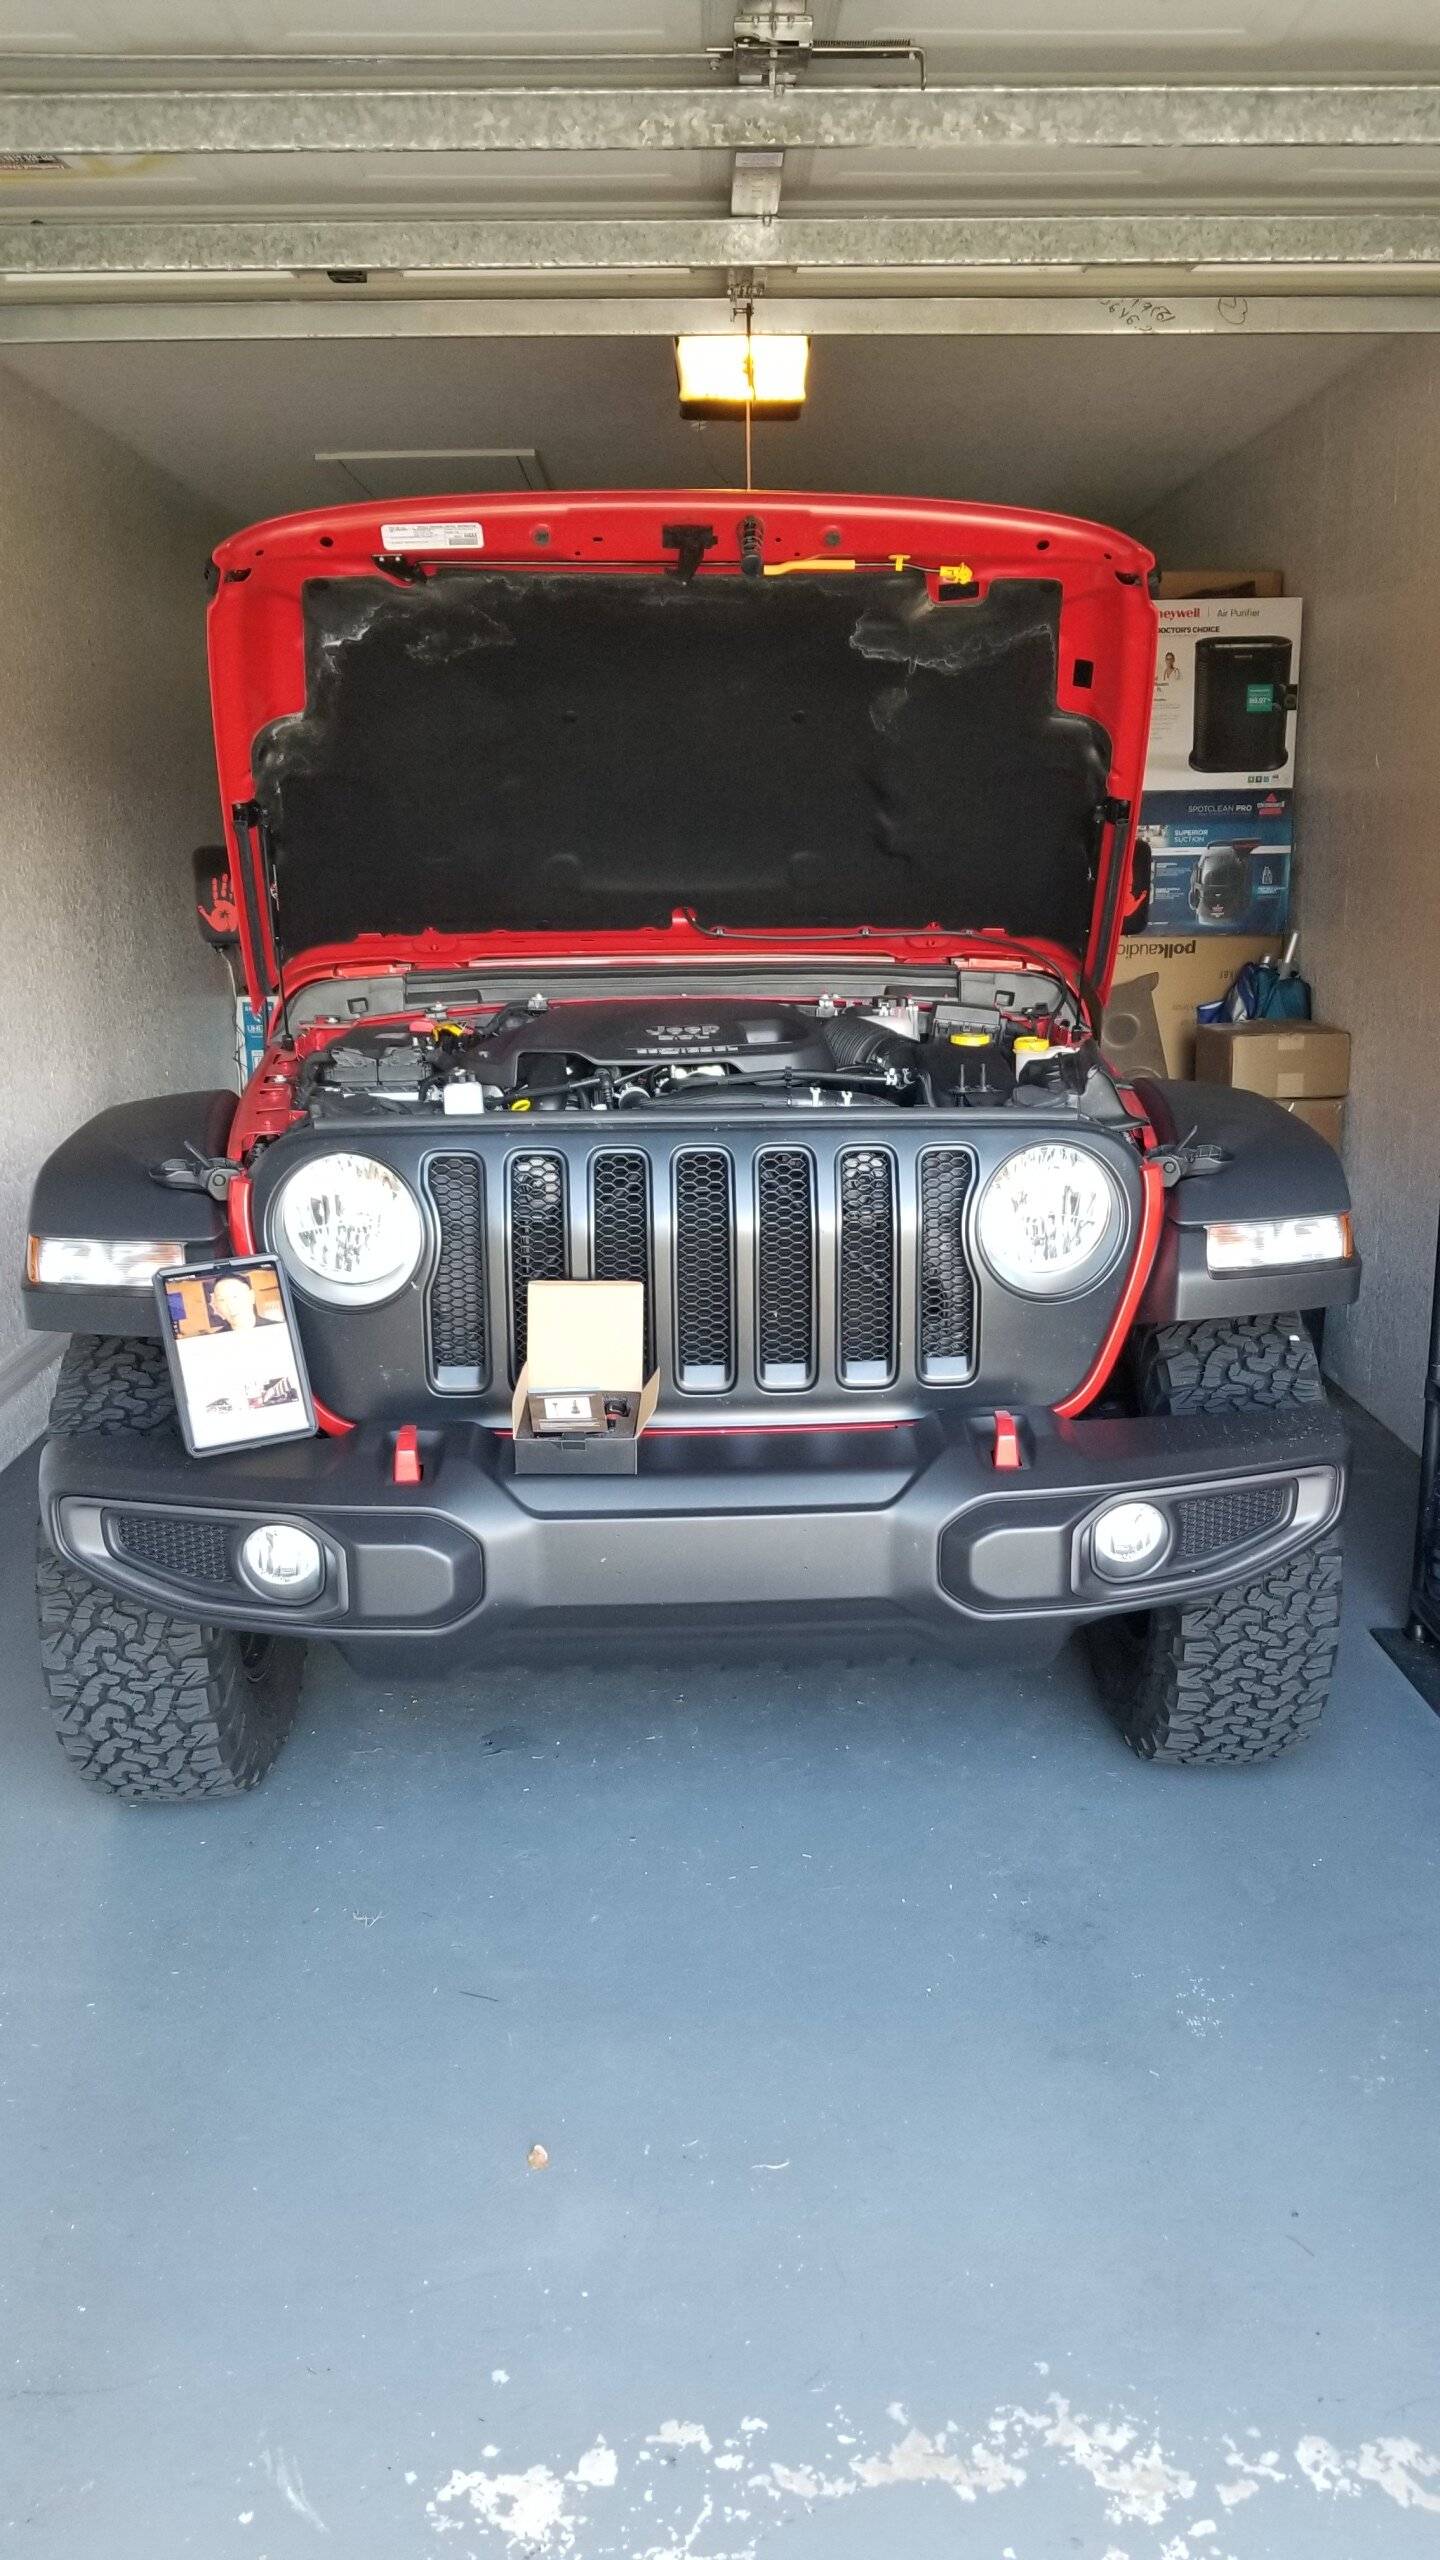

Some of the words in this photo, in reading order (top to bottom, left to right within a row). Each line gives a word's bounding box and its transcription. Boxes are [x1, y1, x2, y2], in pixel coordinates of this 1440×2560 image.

[1217, 609, 1227, 617] Air
[1231, 608, 1260, 617] Purifier
[1192, 625, 1220, 633] CHOICE
[1188, 804, 1234, 813] SPOTCLEAN
[1236, 804, 1253, 812] PRO
